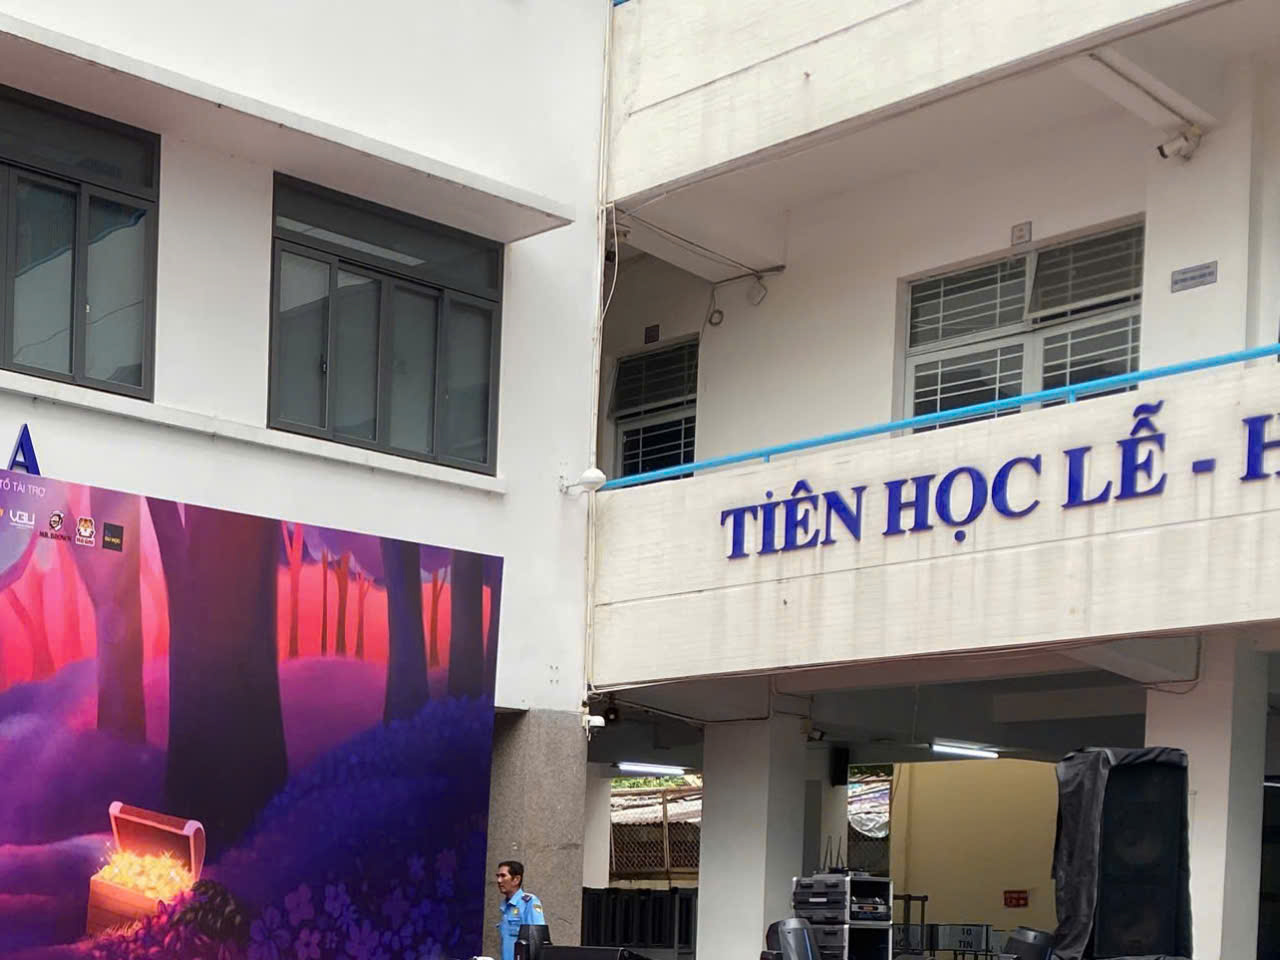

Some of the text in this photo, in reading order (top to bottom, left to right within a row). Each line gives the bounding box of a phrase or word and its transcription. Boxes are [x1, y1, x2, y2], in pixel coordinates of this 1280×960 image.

[7, 423, 41, 476] A
[882, 455, 1042, 543] HỌC
[1061, 400, 1168, 510] LỄ
